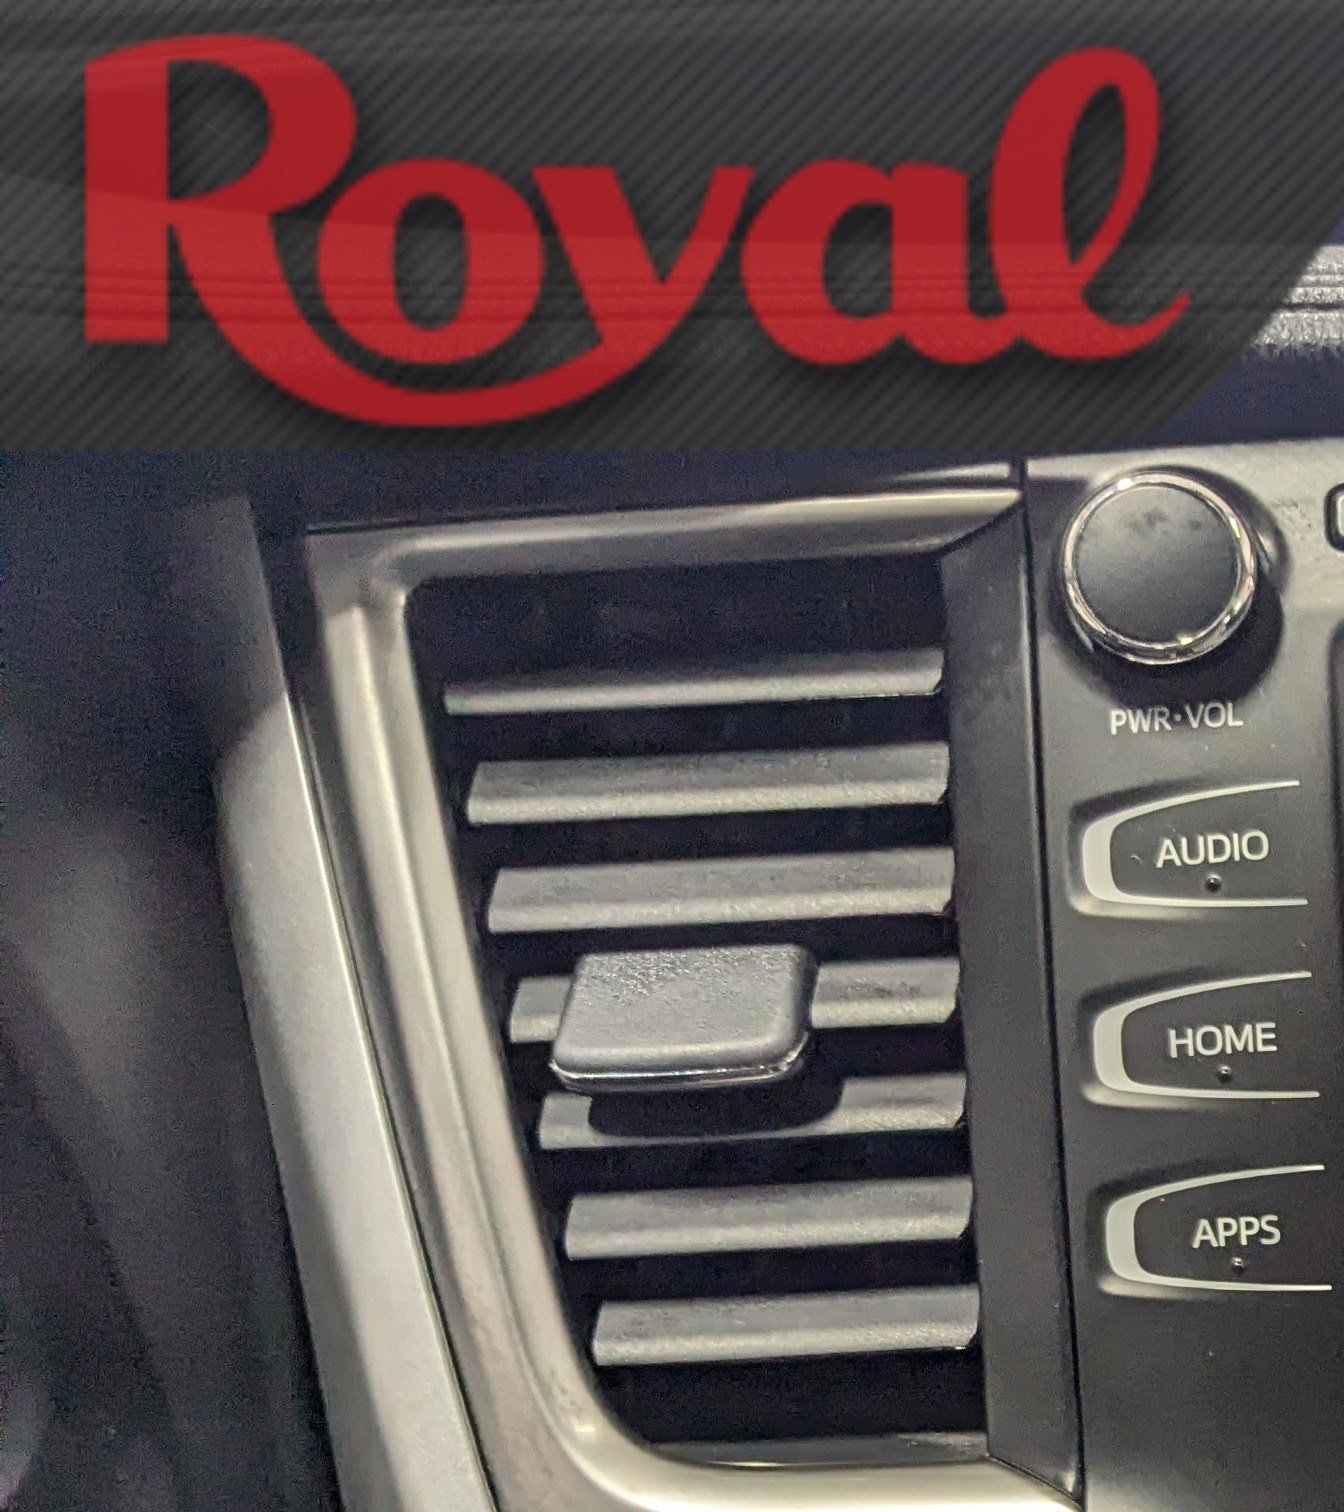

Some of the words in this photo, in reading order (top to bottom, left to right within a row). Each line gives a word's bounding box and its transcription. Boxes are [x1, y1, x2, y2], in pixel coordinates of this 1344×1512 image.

[1156, 830, 1270, 868] AUDIO
[1168, 1021, 1278, 1059] HOME
[1191, 1214, 1281, 1249] APPS
